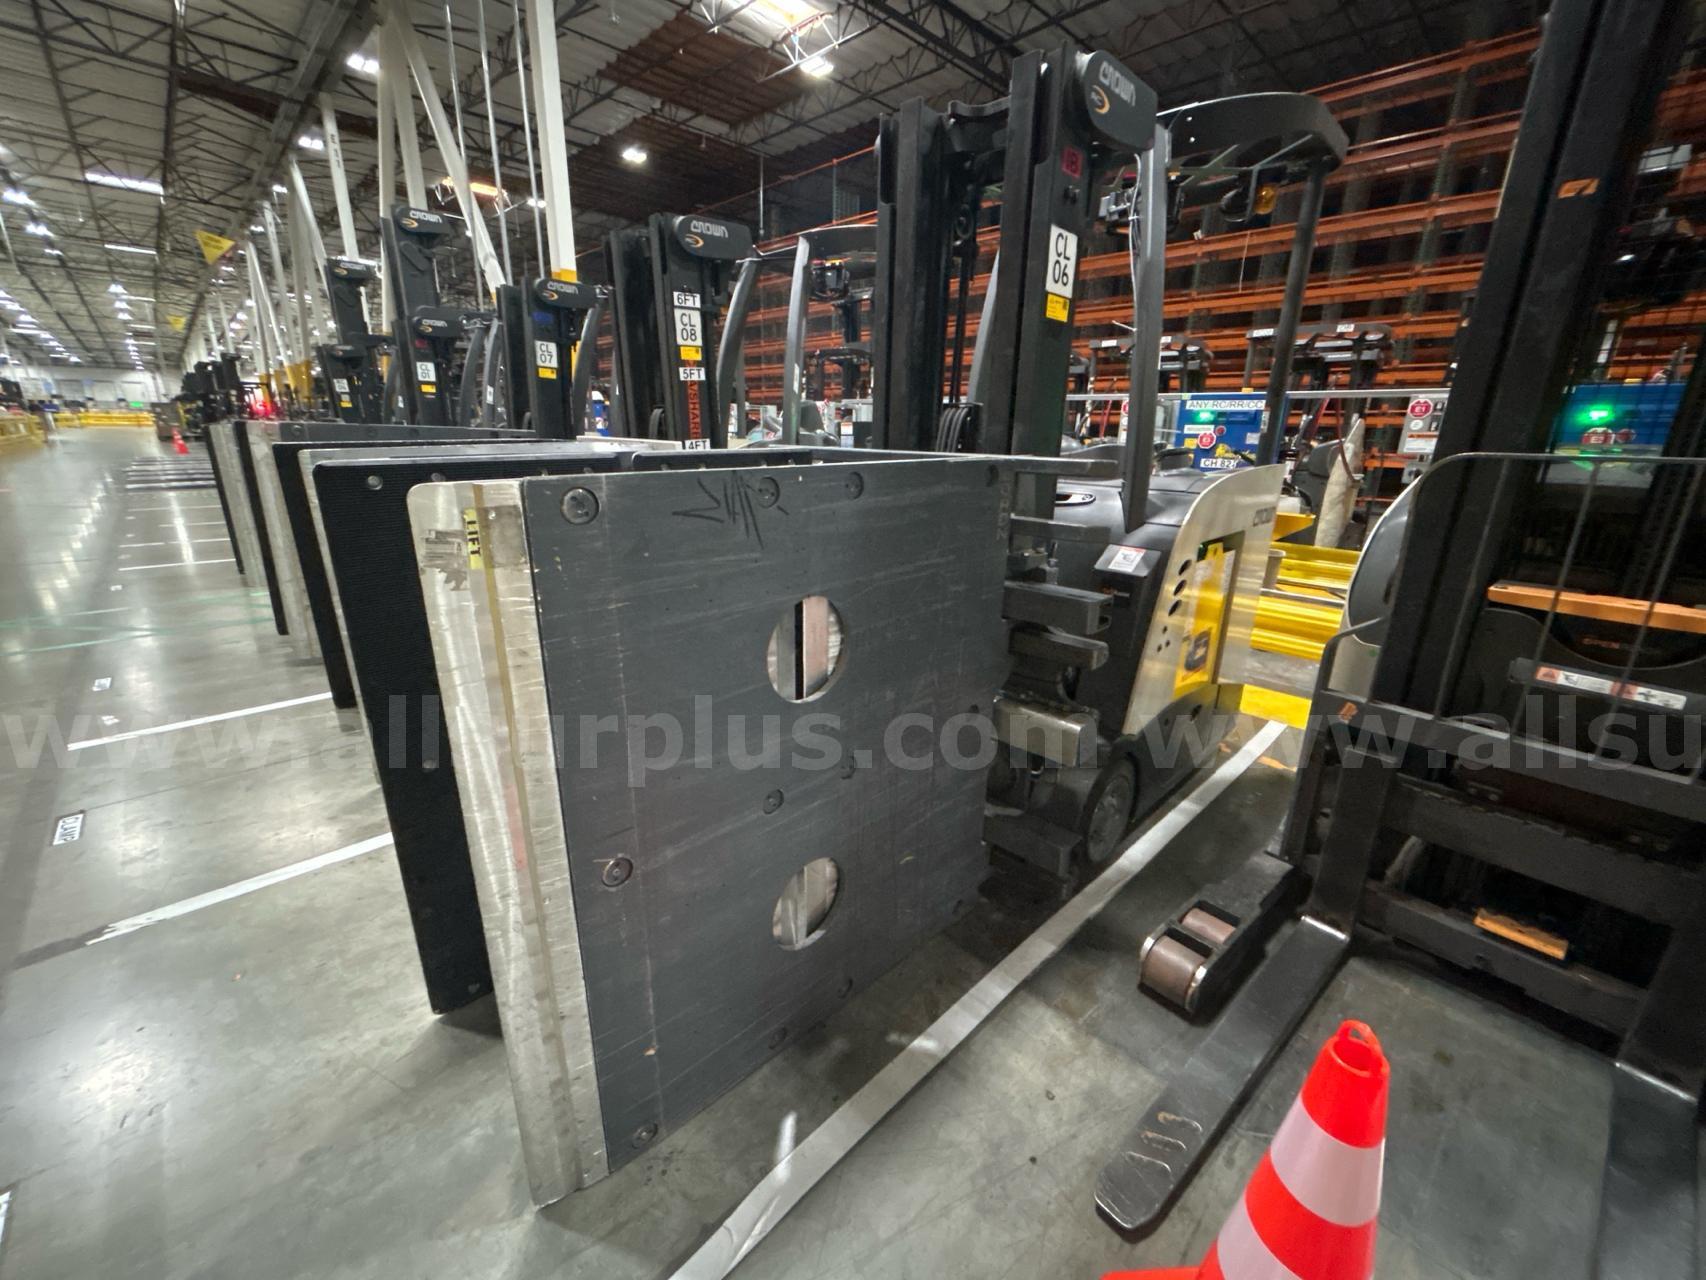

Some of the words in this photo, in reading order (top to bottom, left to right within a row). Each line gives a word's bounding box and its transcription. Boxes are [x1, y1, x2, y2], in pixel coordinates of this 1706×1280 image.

[1099, 60, 1136, 107] CROWN
[409, 210, 442, 223] CROWN
[690, 220, 728, 238] CROWN
[1055, 232, 1071, 261] CL
[1052, 259, 1069, 287] 06
[547, 281, 579, 294] CROWN
[677, 293, 697, 306] 6FT
[680, 312, 697, 328] CL
[681, 328, 698, 342] 08
[539, 343, 552, 354] CL
[540, 354, 553, 364] 07
[682, 368, 702, 380] 5FT
[1188, 400, 1209, 409] ANY
[688, 440, 707, 450] 4FT
[1203, 459, 1217, 467] CH
[466, 520, 481, 557] LIFT
